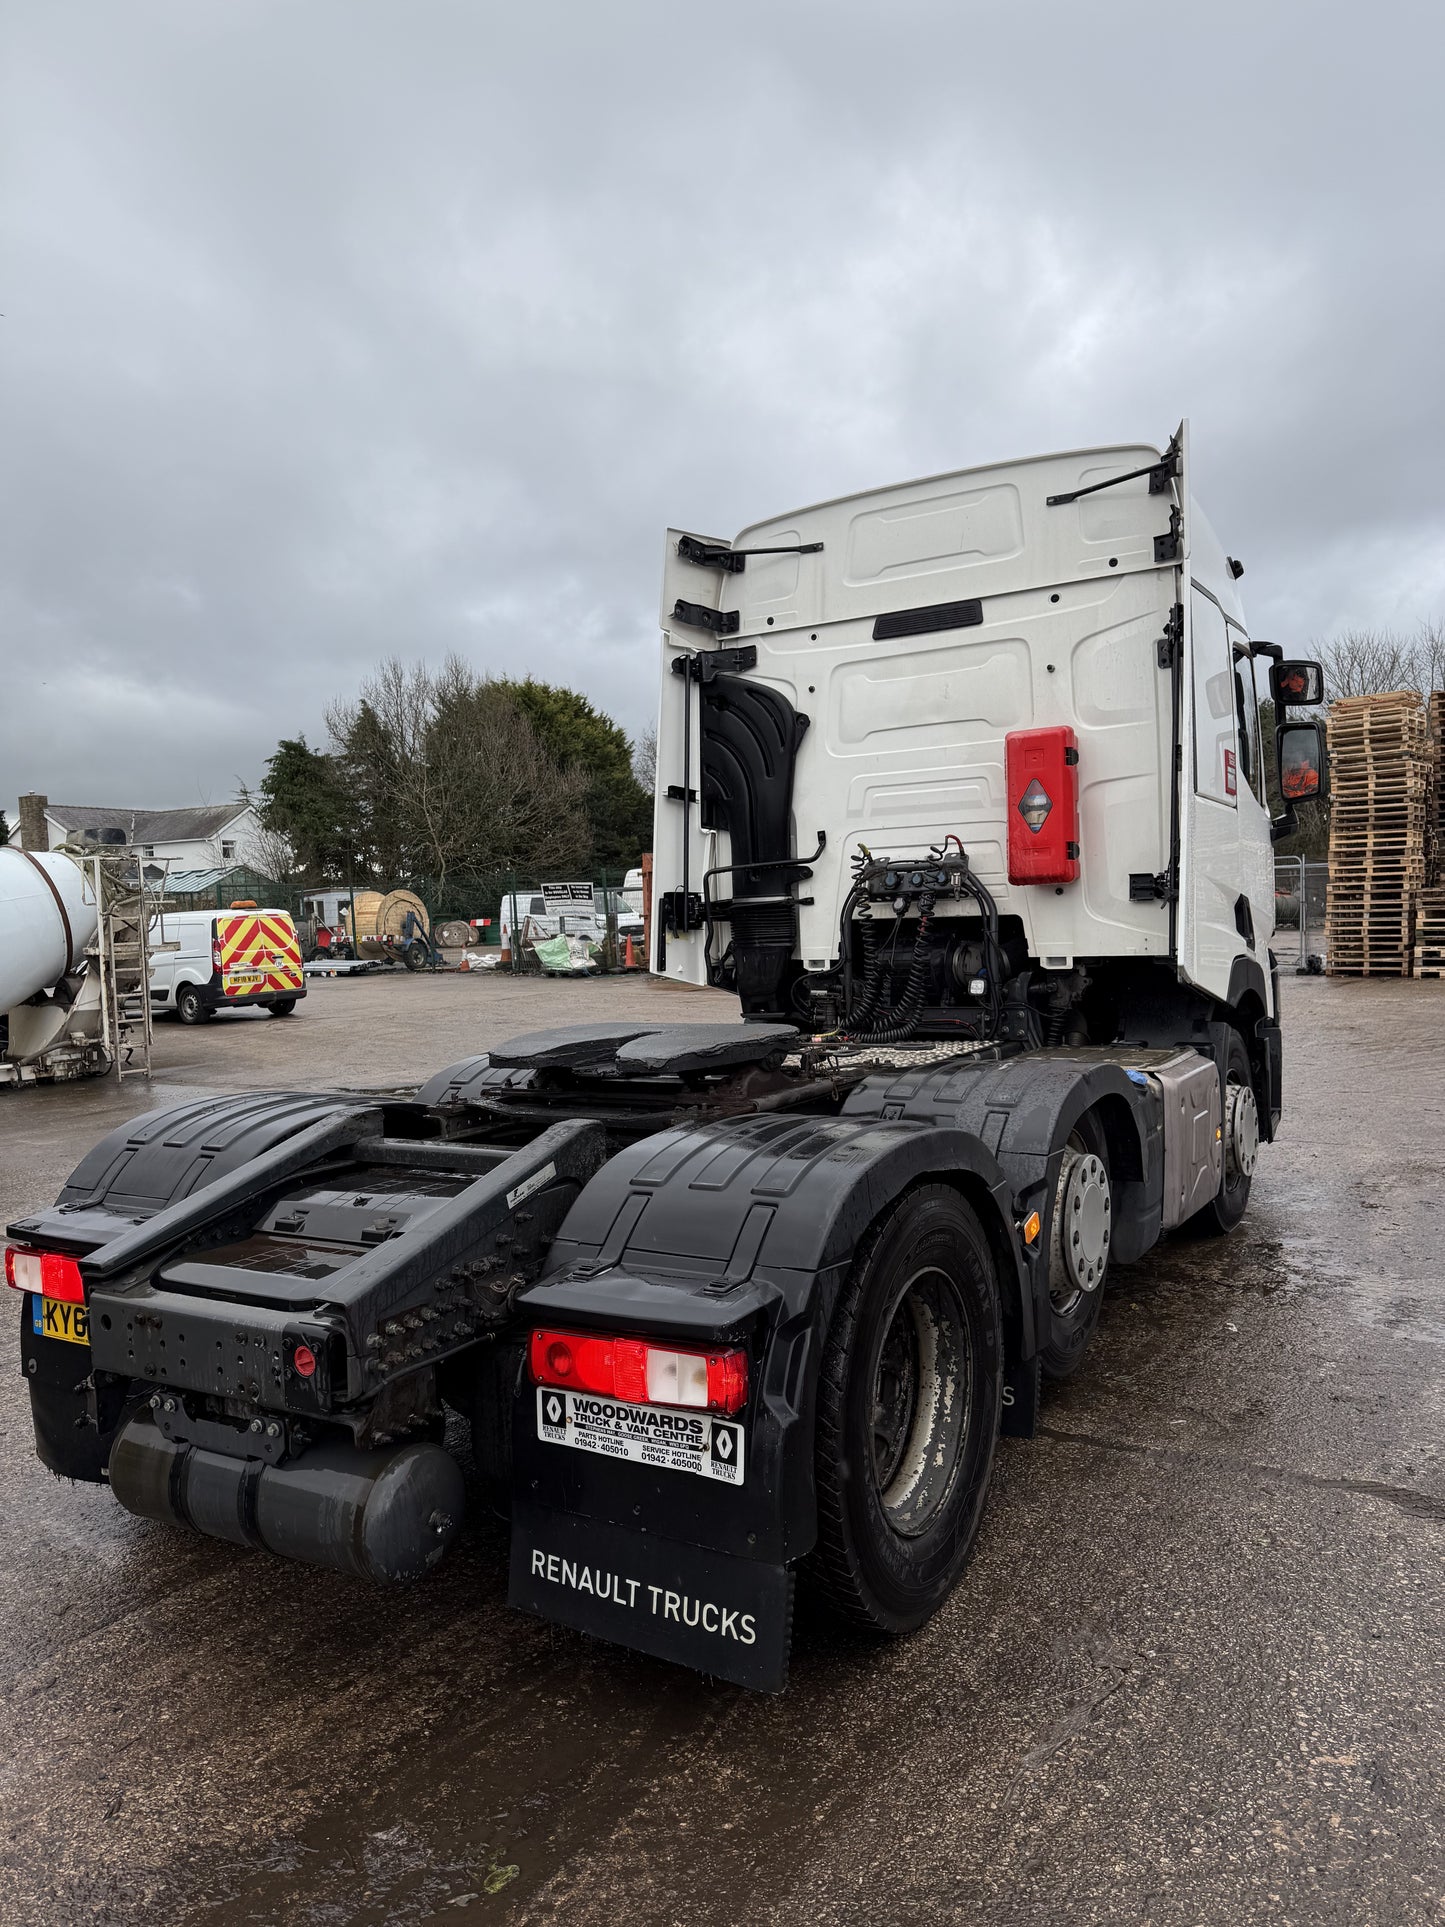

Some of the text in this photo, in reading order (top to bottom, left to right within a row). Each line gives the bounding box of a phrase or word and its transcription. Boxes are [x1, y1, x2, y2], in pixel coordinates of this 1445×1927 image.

[572, 1398, 703, 1434] WOODWARDS
[543, 1425, 566, 1435] RENAULT
[574, 1412, 702, 1444] TRUCK & VAN CENTRE
[544, 1432, 565, 1440] TRUCKS
[579, 1431, 624, 1446] PARTS HOTLINE
[642, 1445, 700, 1460] SERVICE HOTLINE
[711, 1461, 737, 1473] RENAULT
[712, 1468, 736, 1480] TRUCKS
[532, 1549, 757, 1644] RENAULT TRUCKS
